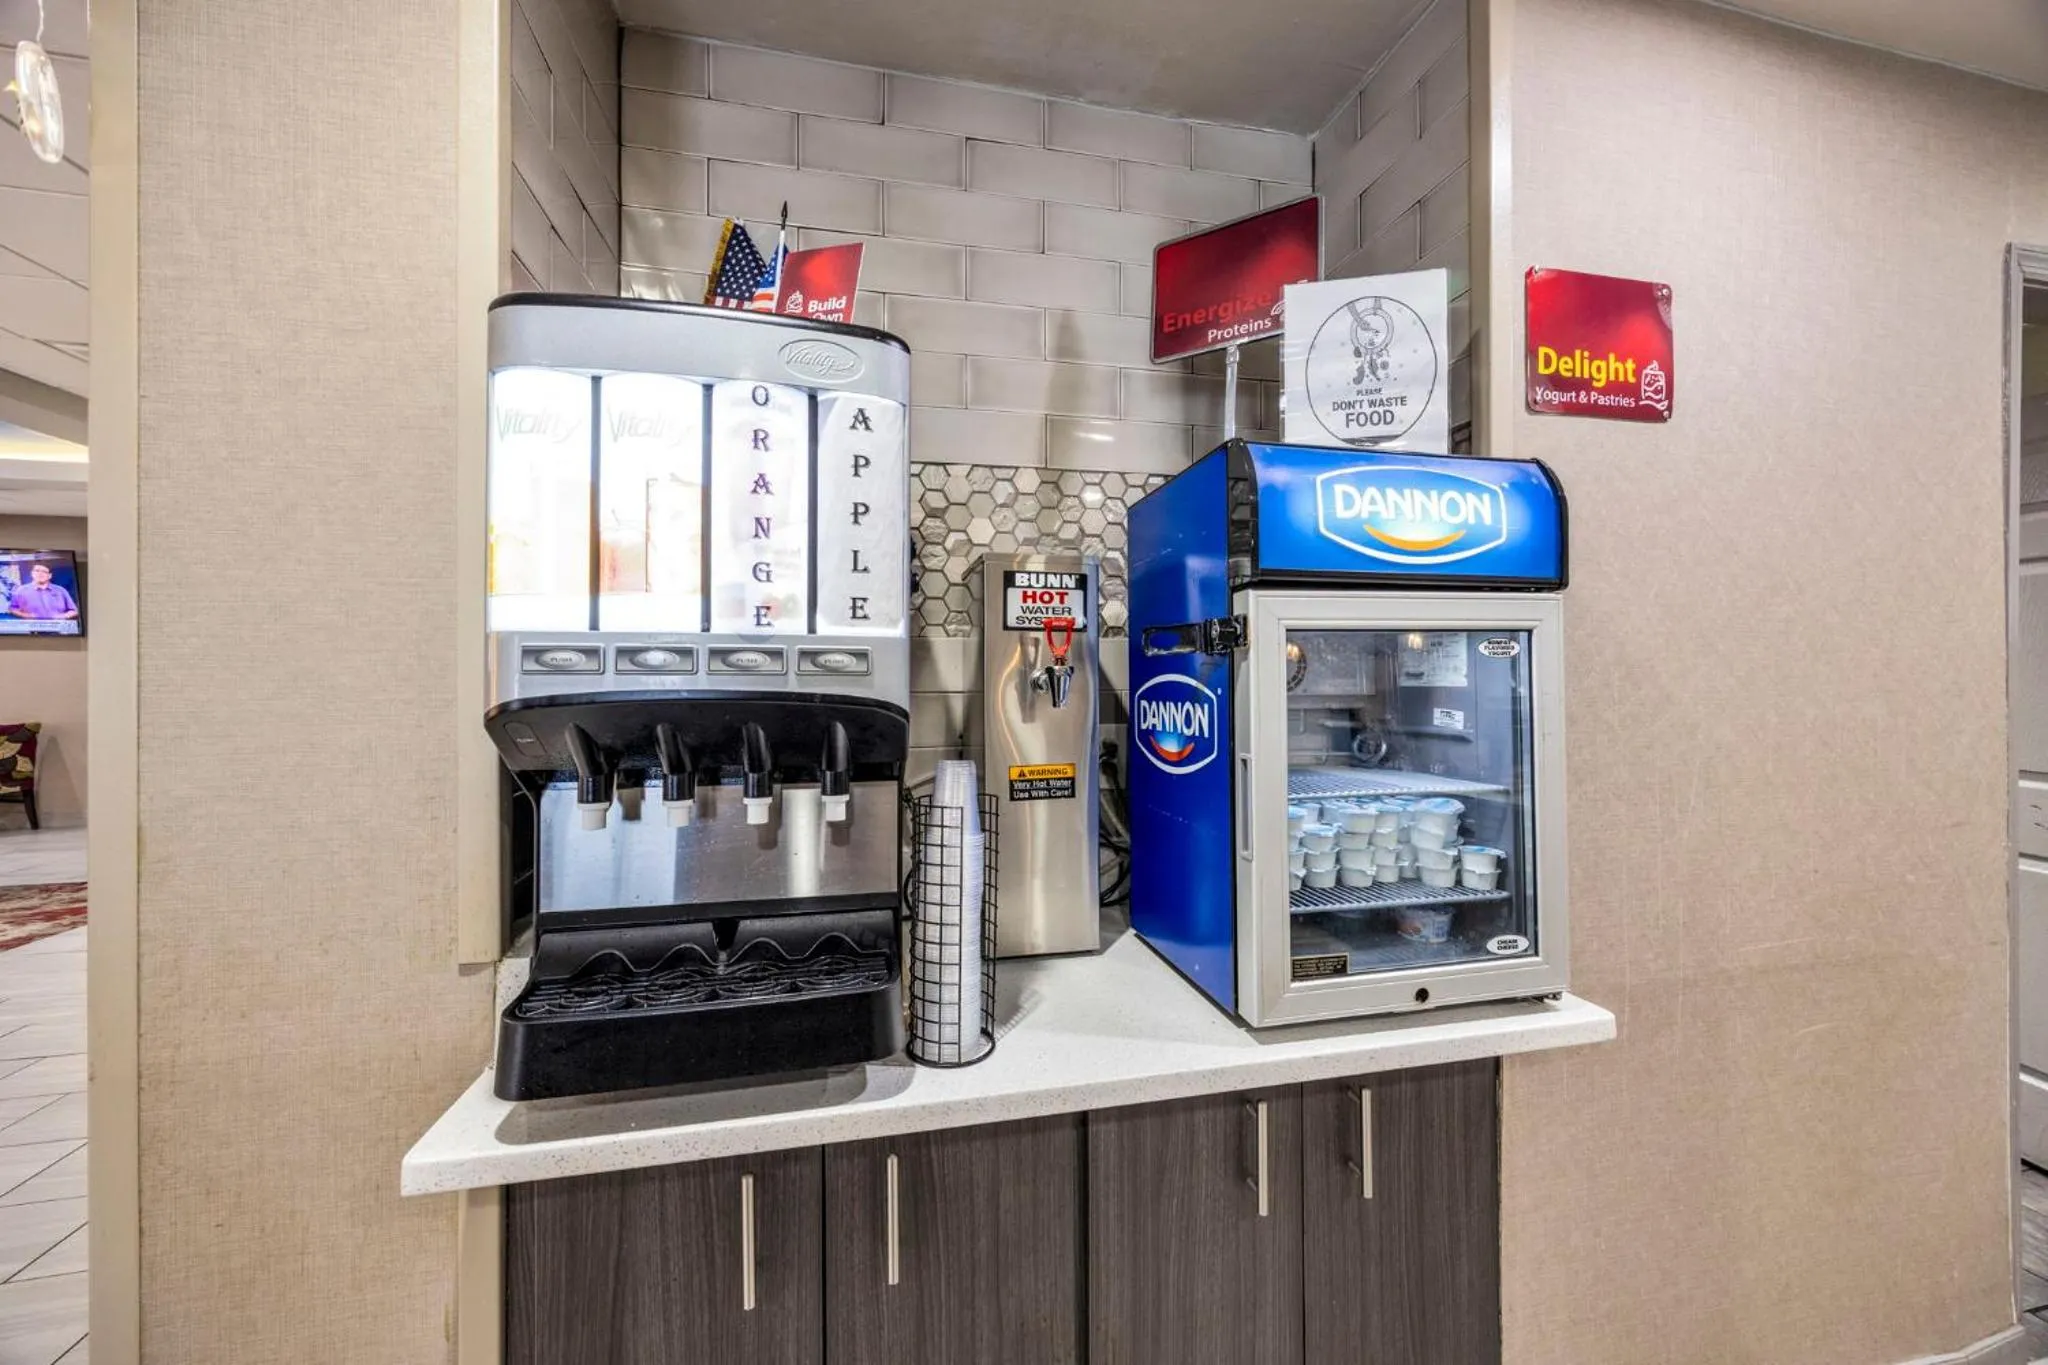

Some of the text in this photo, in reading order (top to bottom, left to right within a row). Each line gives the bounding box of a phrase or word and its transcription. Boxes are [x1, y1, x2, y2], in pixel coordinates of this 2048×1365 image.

[808, 296, 847, 313] Build
[1163, 291, 1273, 334] Energize
[1207, 317, 1272, 342] Proteins
[1537, 345, 1637, 388] Delight
[1356, 387, 1383, 397] PLEASE
[1535, 386, 1636, 408] Yogurt & Pastries
[1332, 395, 1408, 411] DON'T WASTE
[1345, 410, 1395, 429] FOOD
[751, 384, 774, 628] ORANGE
[1333, 482, 1493, 527] DANNON
[849, 407, 873, 621] APPLE
[1015, 572, 1076, 589] BUNN
[1022, 590, 1069, 605] HOT
[1020, 605, 1072, 616] WATER
[1140, 699, 1209, 739] DANNON
[1027, 767, 1069, 777] WARNING
[1013, 779, 1072, 791] Very Hot Water
[1014, 790, 1029, 799] Use
[1031, 789, 1049, 798] With
